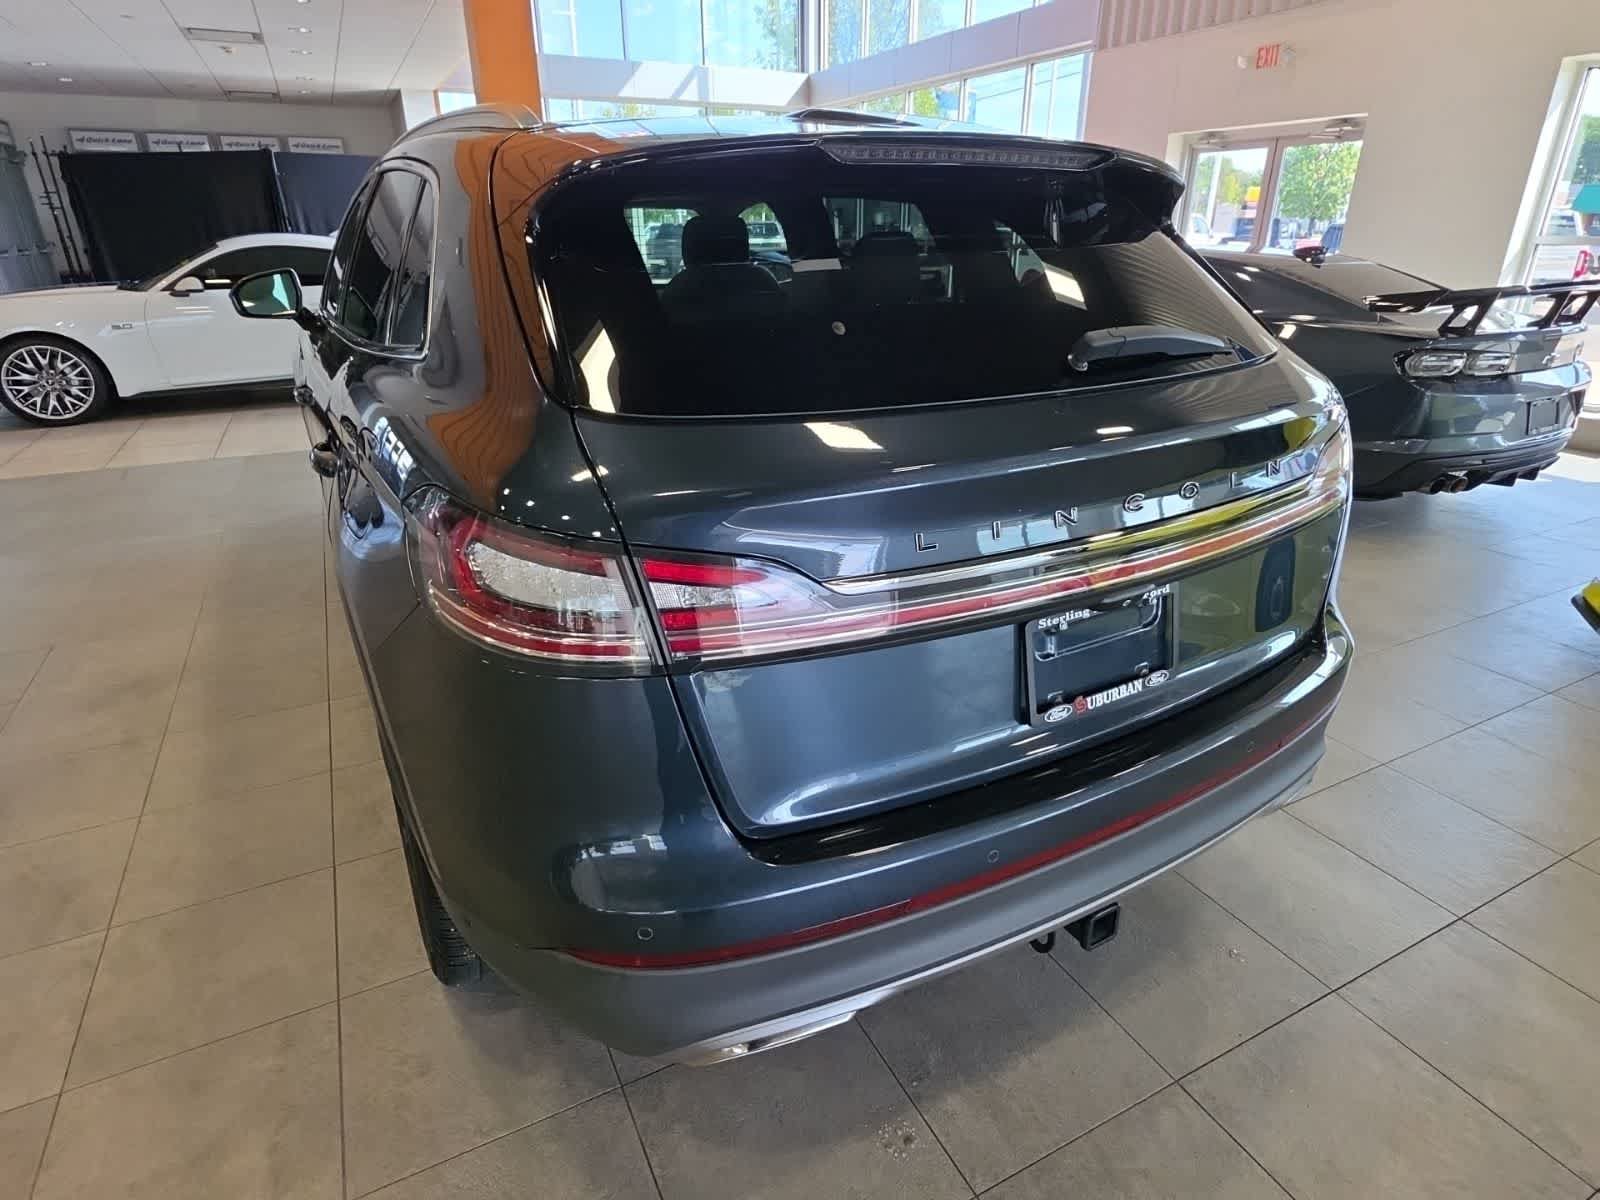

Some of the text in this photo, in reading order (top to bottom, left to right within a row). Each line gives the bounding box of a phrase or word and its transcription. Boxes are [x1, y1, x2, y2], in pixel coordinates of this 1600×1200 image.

[1256, 44, 1280, 69] EXIT
[914, 459, 1282, 553] LINCOLN
[1038, 609, 1090, 629] Sterling
[1073, 679, 1143, 713] SUBURBAN
